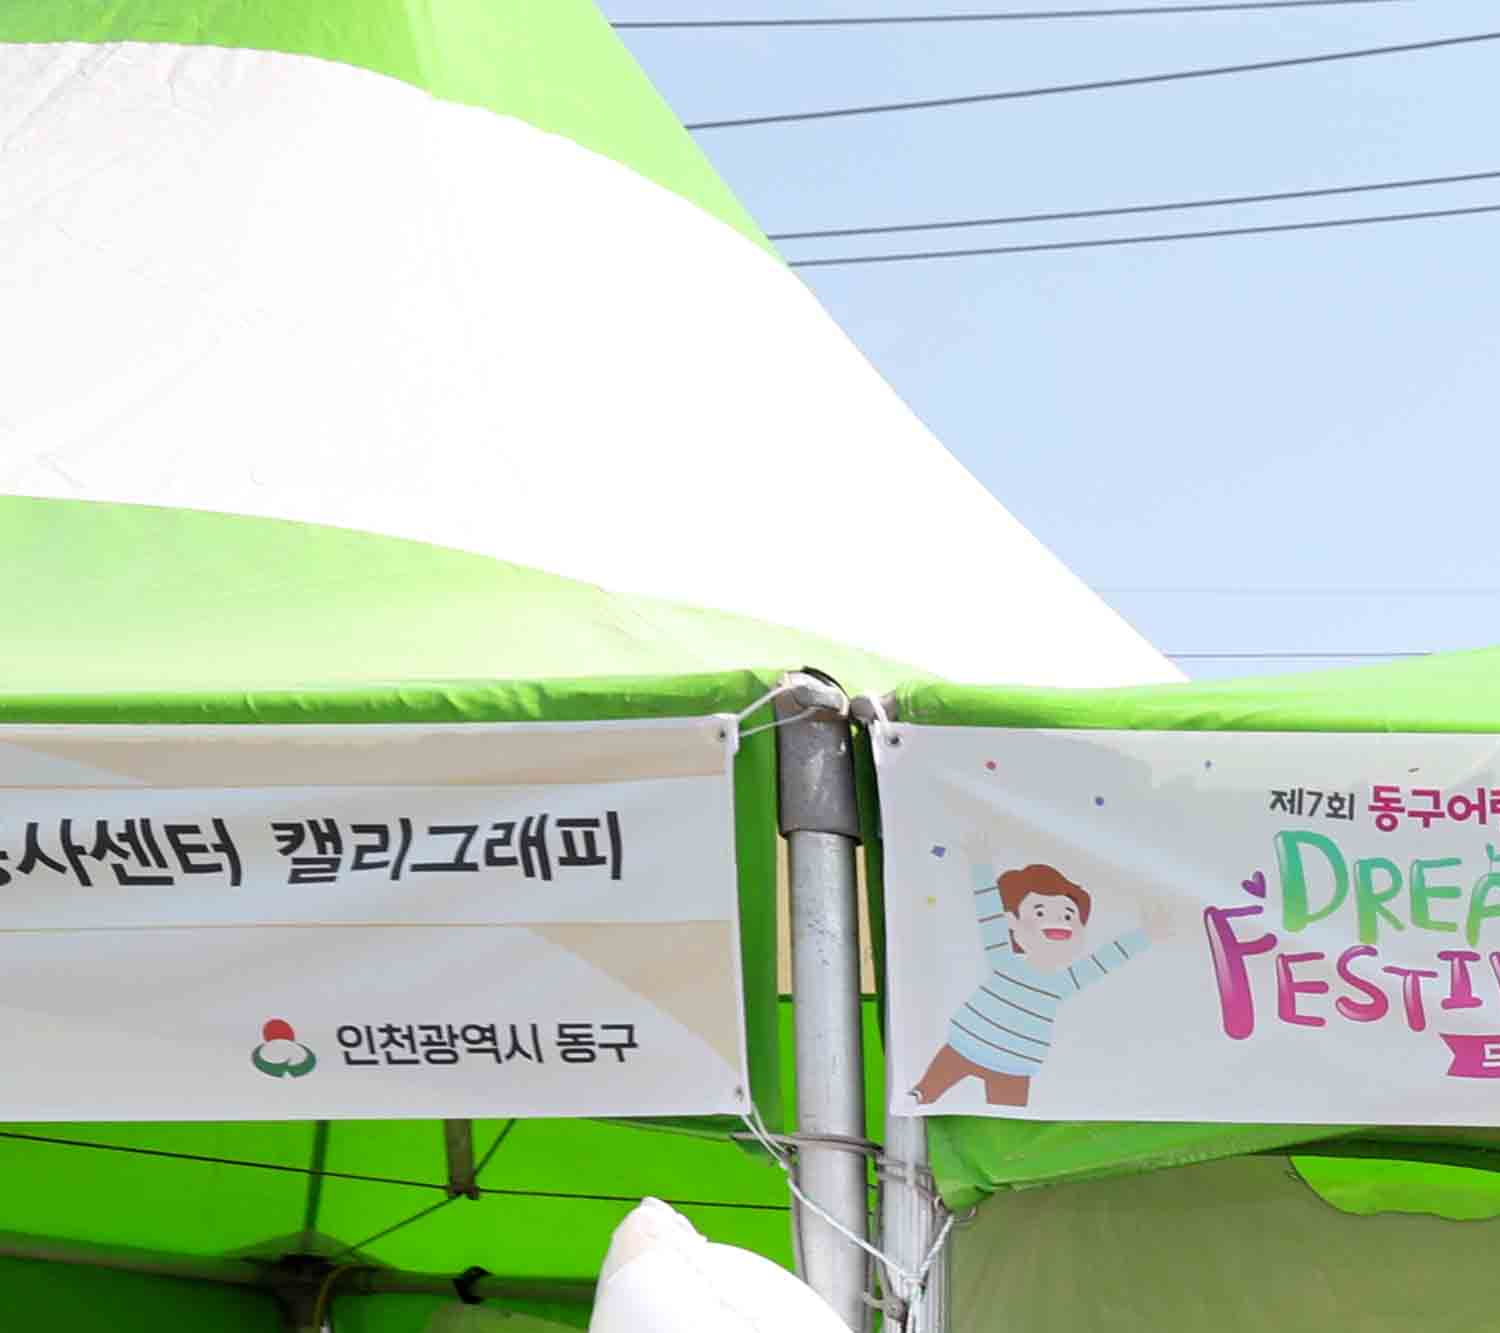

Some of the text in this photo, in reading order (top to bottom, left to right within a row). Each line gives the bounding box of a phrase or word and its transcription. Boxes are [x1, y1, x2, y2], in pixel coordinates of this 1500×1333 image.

[1269, 787, 1356, 822] 제7회
[0, 810, 624, 888] 사센터 캘리그래피
[335, 1022, 640, 1066] 인천광역시 동구
